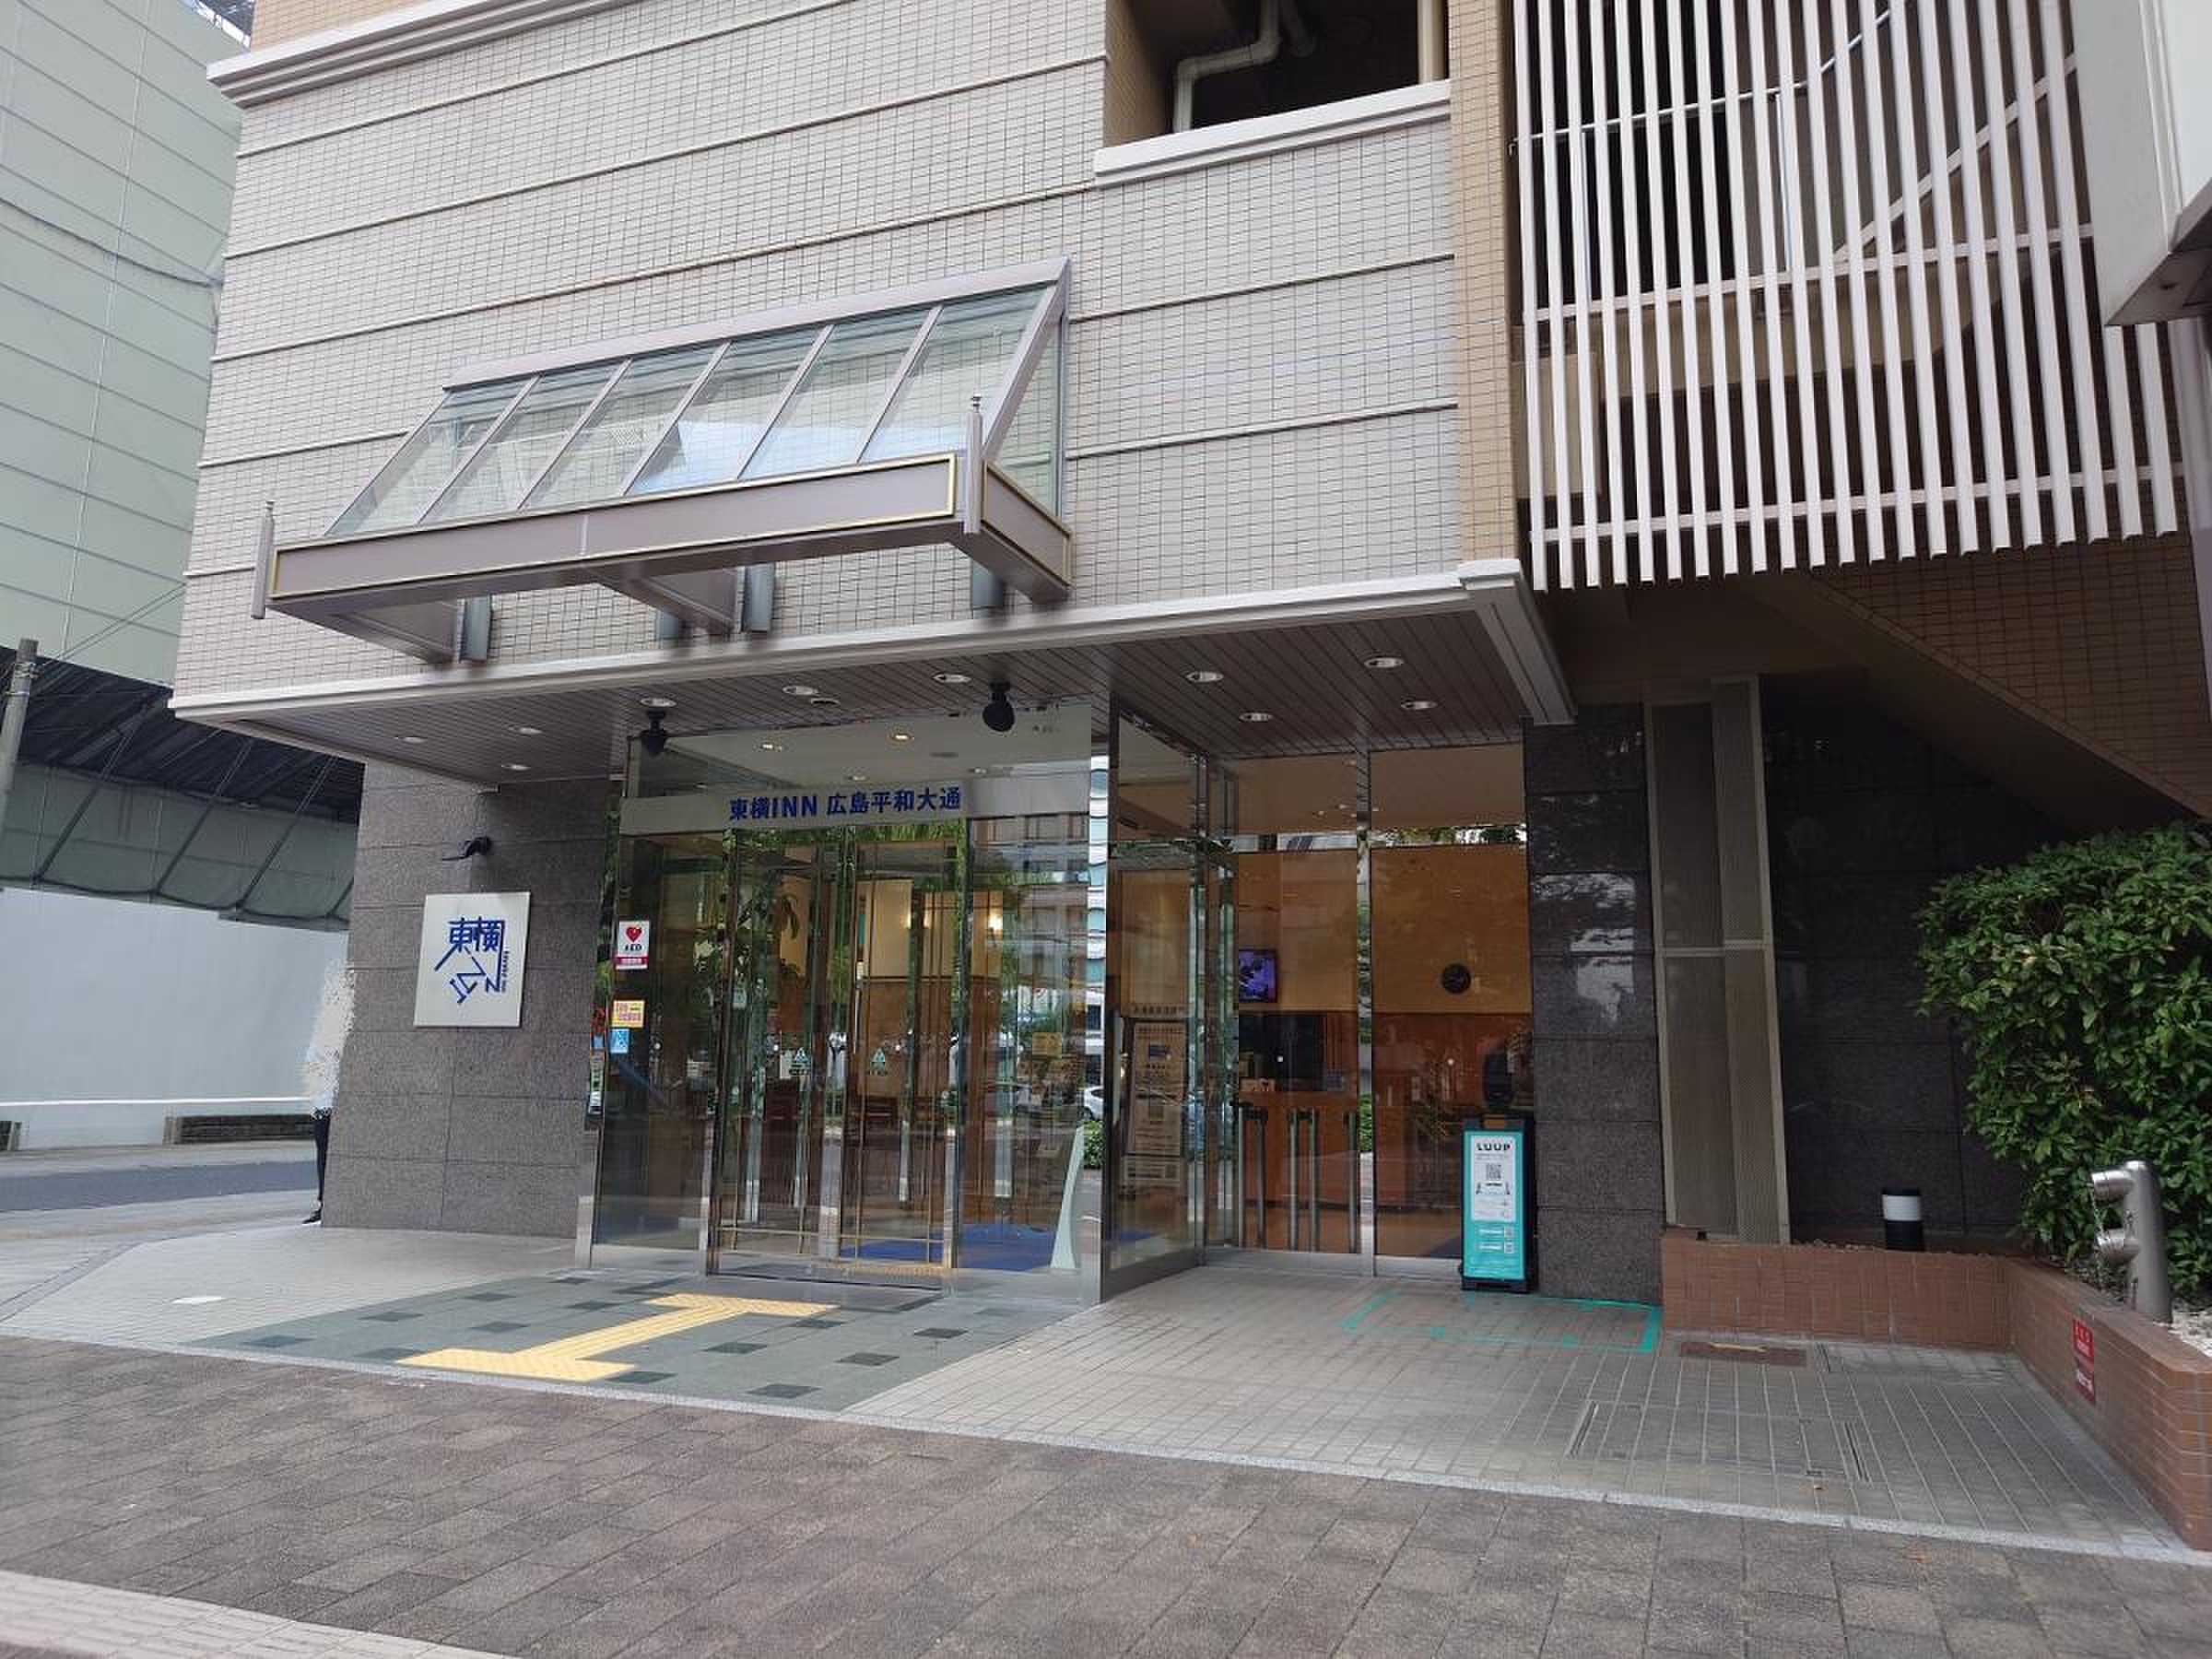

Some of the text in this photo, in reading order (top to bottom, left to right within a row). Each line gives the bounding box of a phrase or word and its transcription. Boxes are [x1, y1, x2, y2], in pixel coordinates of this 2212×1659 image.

[729, 786, 961, 821] 東横INN 広島平和大通
[1477, 1142, 1511, 1151] LUUP
